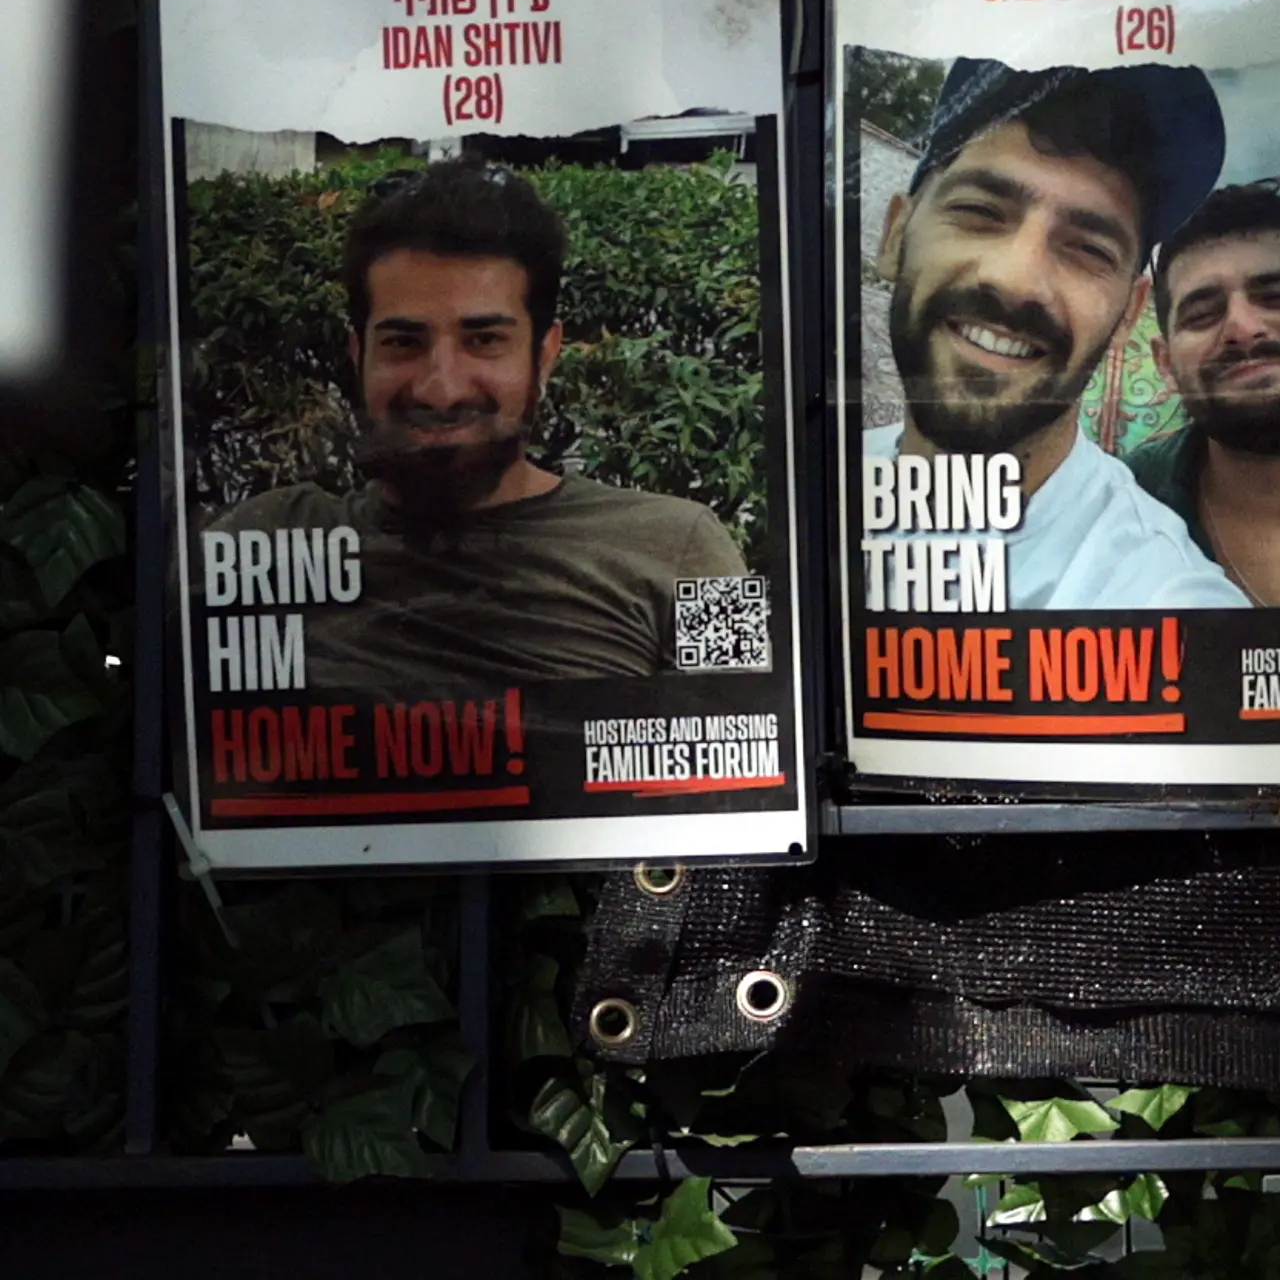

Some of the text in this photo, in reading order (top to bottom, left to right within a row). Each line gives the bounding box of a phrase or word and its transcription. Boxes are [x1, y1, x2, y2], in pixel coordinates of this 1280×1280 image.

[383, 22, 562, 70] IDAN SHTIVI
[1116, 8, 1175, 54] (26)
[443, 75, 502, 124] (28)
[862, 453, 1020, 532] BRING
[862, 540, 1007, 613] THEM
[865, 617, 1182, 703] HOME NOW!
[584, 714, 777, 745] HOSTAGES AND MISSING
[586, 741, 779, 783] FAMILIES FORUM
